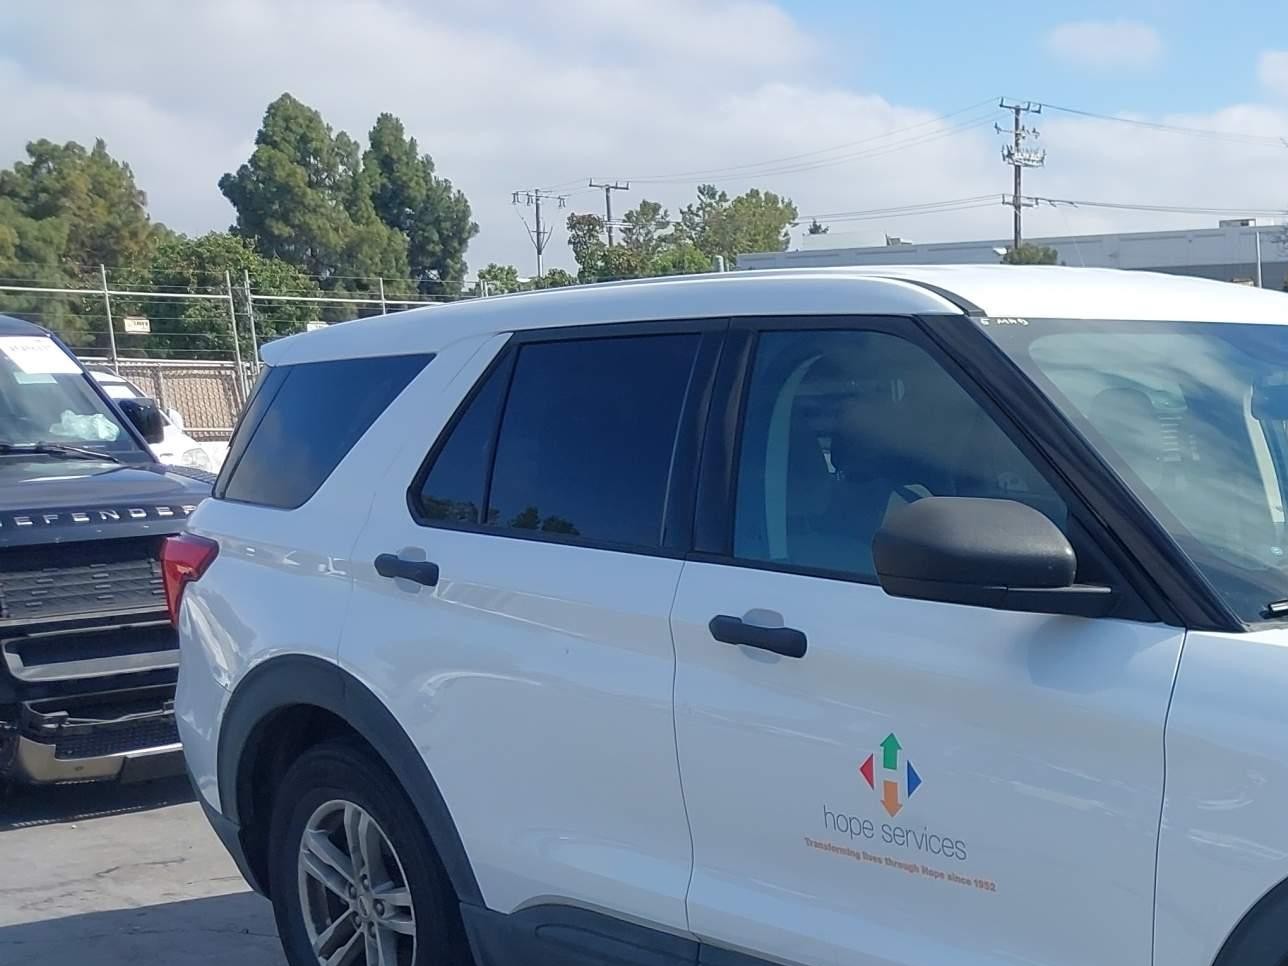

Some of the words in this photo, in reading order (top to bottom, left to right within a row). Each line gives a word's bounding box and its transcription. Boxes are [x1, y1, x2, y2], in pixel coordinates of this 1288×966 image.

[823, 803, 874, 840] hope
[881, 823, 968, 861] services
[804, 837, 861, 861] Transforming
[947, 872, 972, 886] since
[974, 879, 997, 892] 1952
